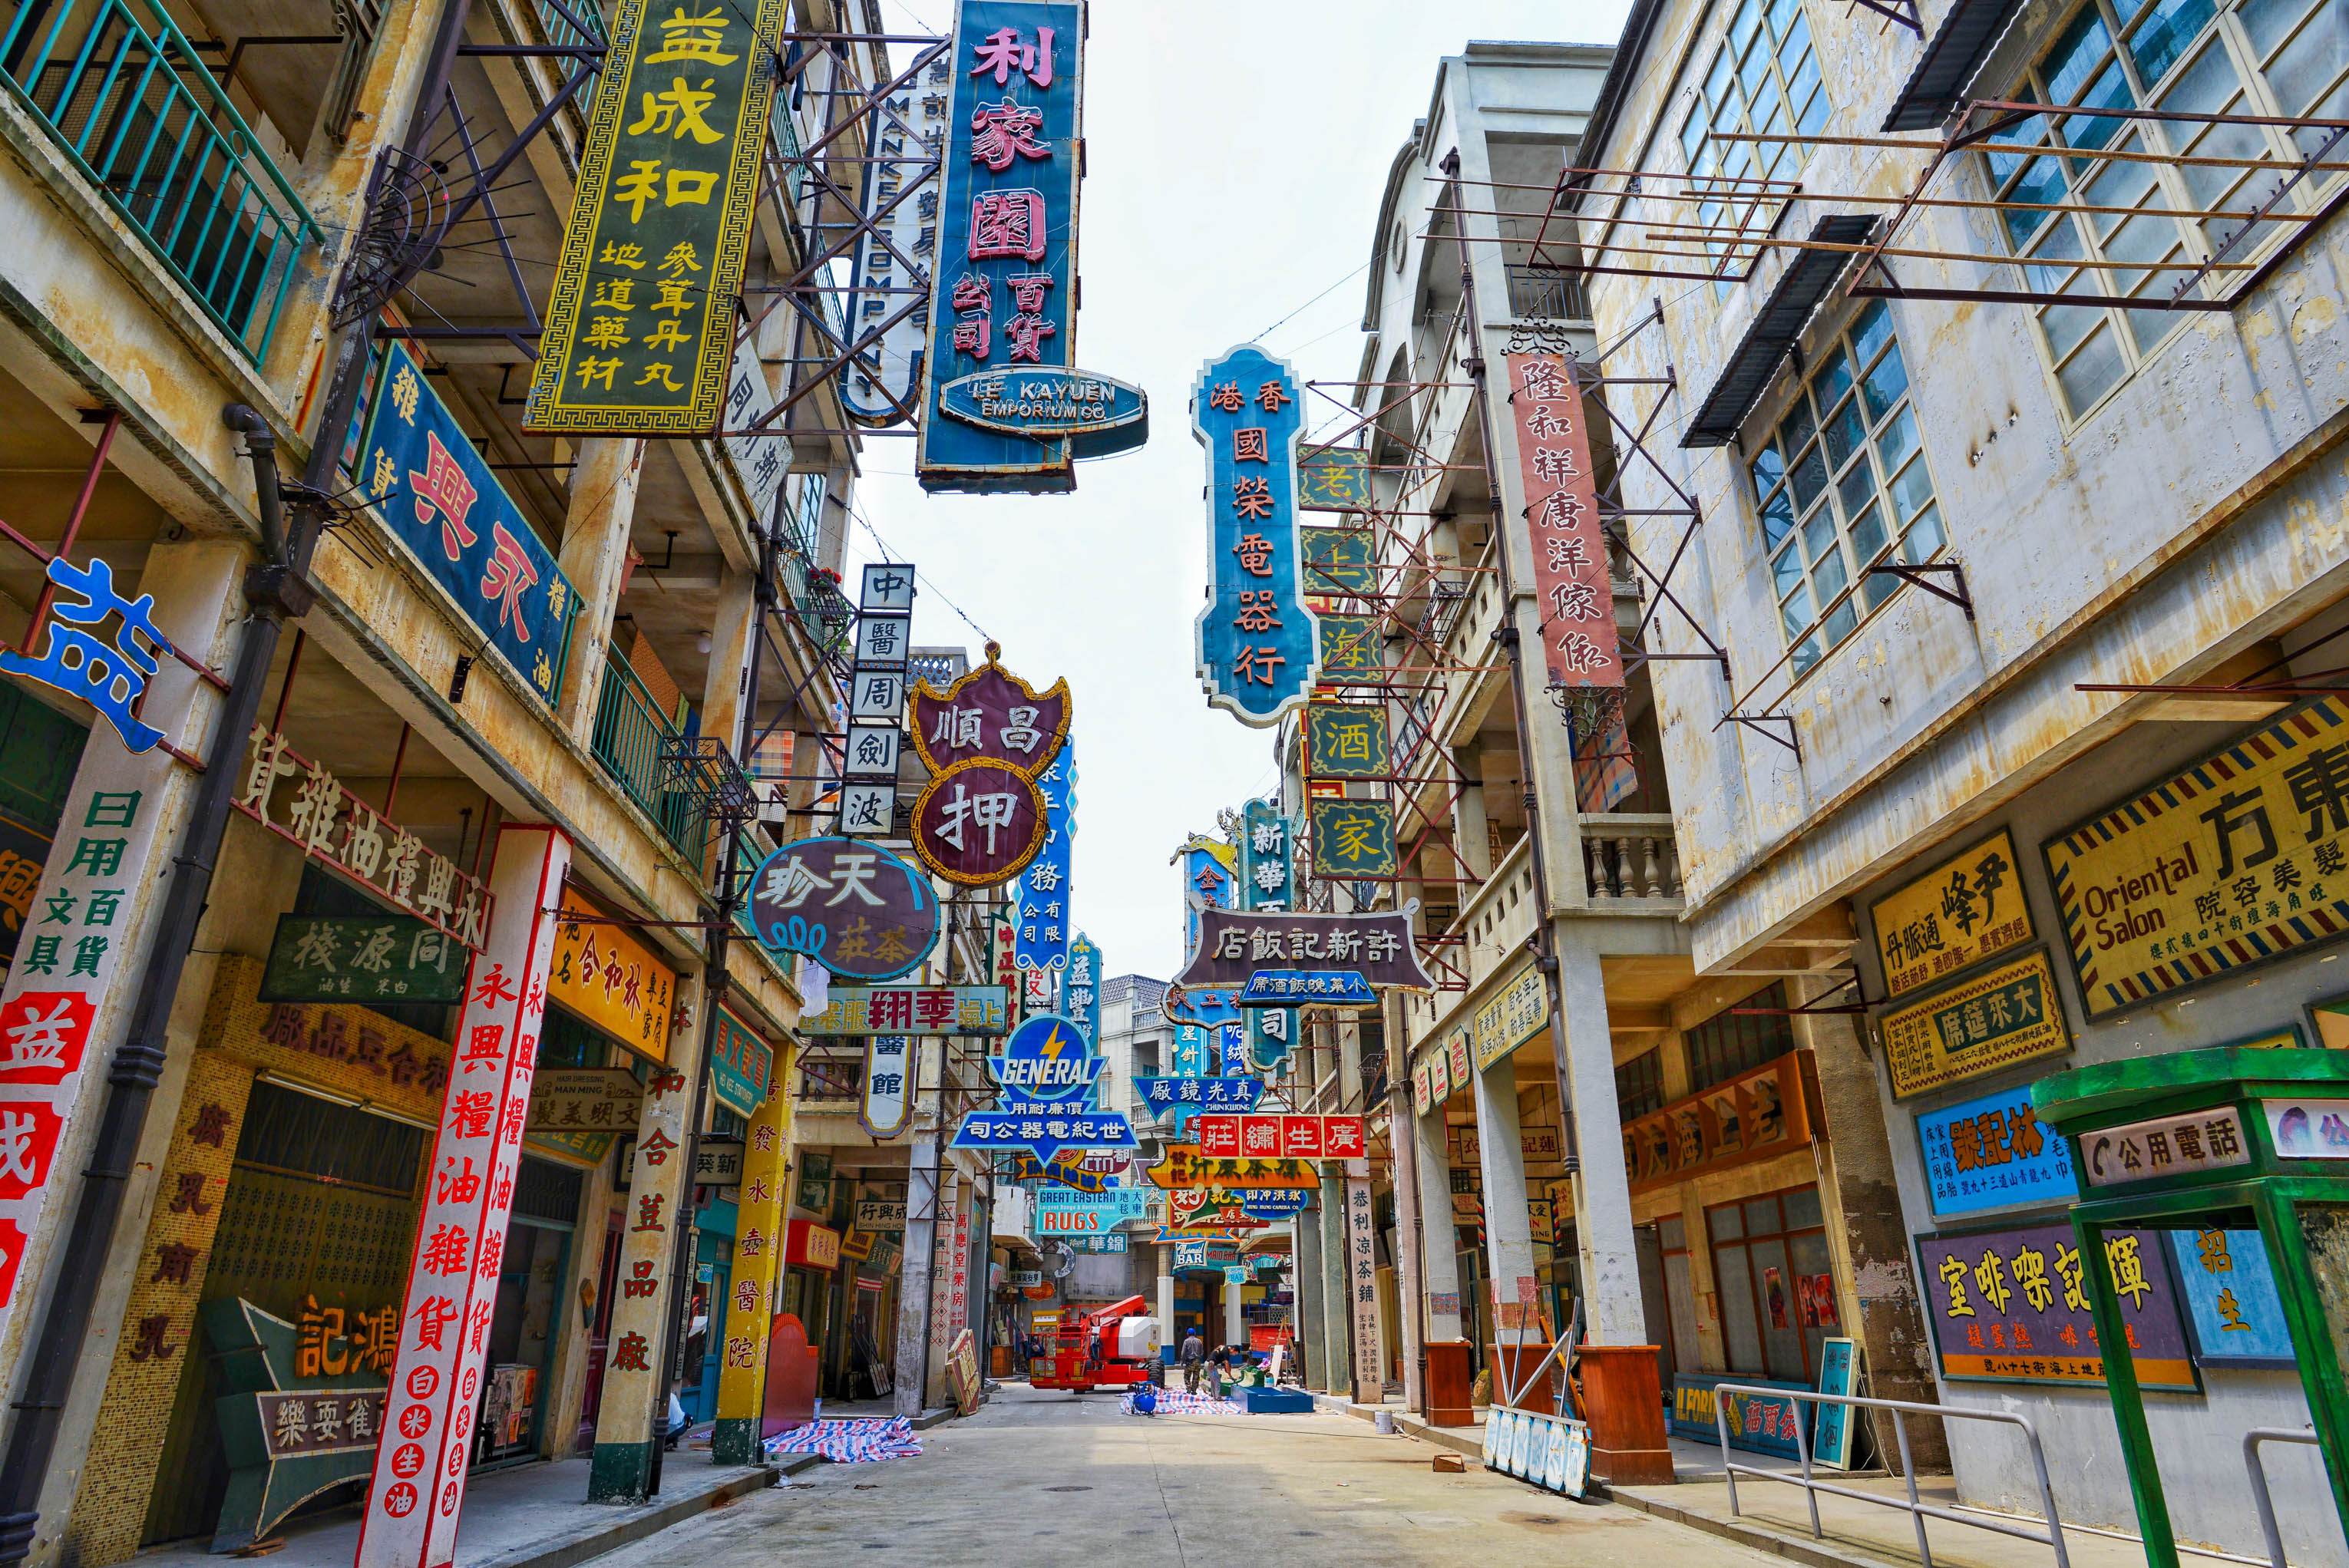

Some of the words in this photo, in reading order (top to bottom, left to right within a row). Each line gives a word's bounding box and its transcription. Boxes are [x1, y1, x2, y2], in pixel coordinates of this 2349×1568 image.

[614, 6, 739, 223] 益成和
[576, 240, 647, 391] 地道藥材
[952, 272, 993, 361] 公司
[1006, 272, 1056, 364] 百貨
[970, 375, 1007, 400] LEE
[982, 398, 1077, 420] EMPORIUM
[1210, 380, 1291, 412] 香港
[1234, 427, 1286, 685] 國榮電器行
[1314, 461, 1379, 860] 老上海酒家
[63, 791, 144, 876] 日用
[934, 783, 1019, 855] 押
[2084, 841, 2199, 919] Oriental
[21, 887, 78, 976] 文具
[67, 889, 125, 978] 百貨
[1211, 926, 1402, 962] 許新記飯店
[2096, 908, 2166, 951] Salon
[554, 1086, 578, 1094] MAN
[580, 1086, 603, 1094] MING
[1001, 1058, 1093, 1085] GENERAL
[966, 1120, 1126, 1141] 世紀電器公司
[1010, 1102, 1083, 1117] 價廉耐用
[411, 963, 518, 1352] 永興糧油雜貨
[468, 972, 543, 1355] 永興糧油雜貨
[2119, 1117, 2240, 1170] 公用電話
[1039, 1192, 1071, 1203] GREAT
[1073, 1192, 1116, 1203] EASTERN
[1044, 1211, 1099, 1230] RUGS
[1178, 1253, 1204, 1265] BAR
[273, 1398, 385, 1448] 雀耍樂
[1677, 1387, 1716, 1425] ILFORD
[385, 1366, 439, 1517] 白米生油
[441, 1368, 476, 1517] 白米生油
